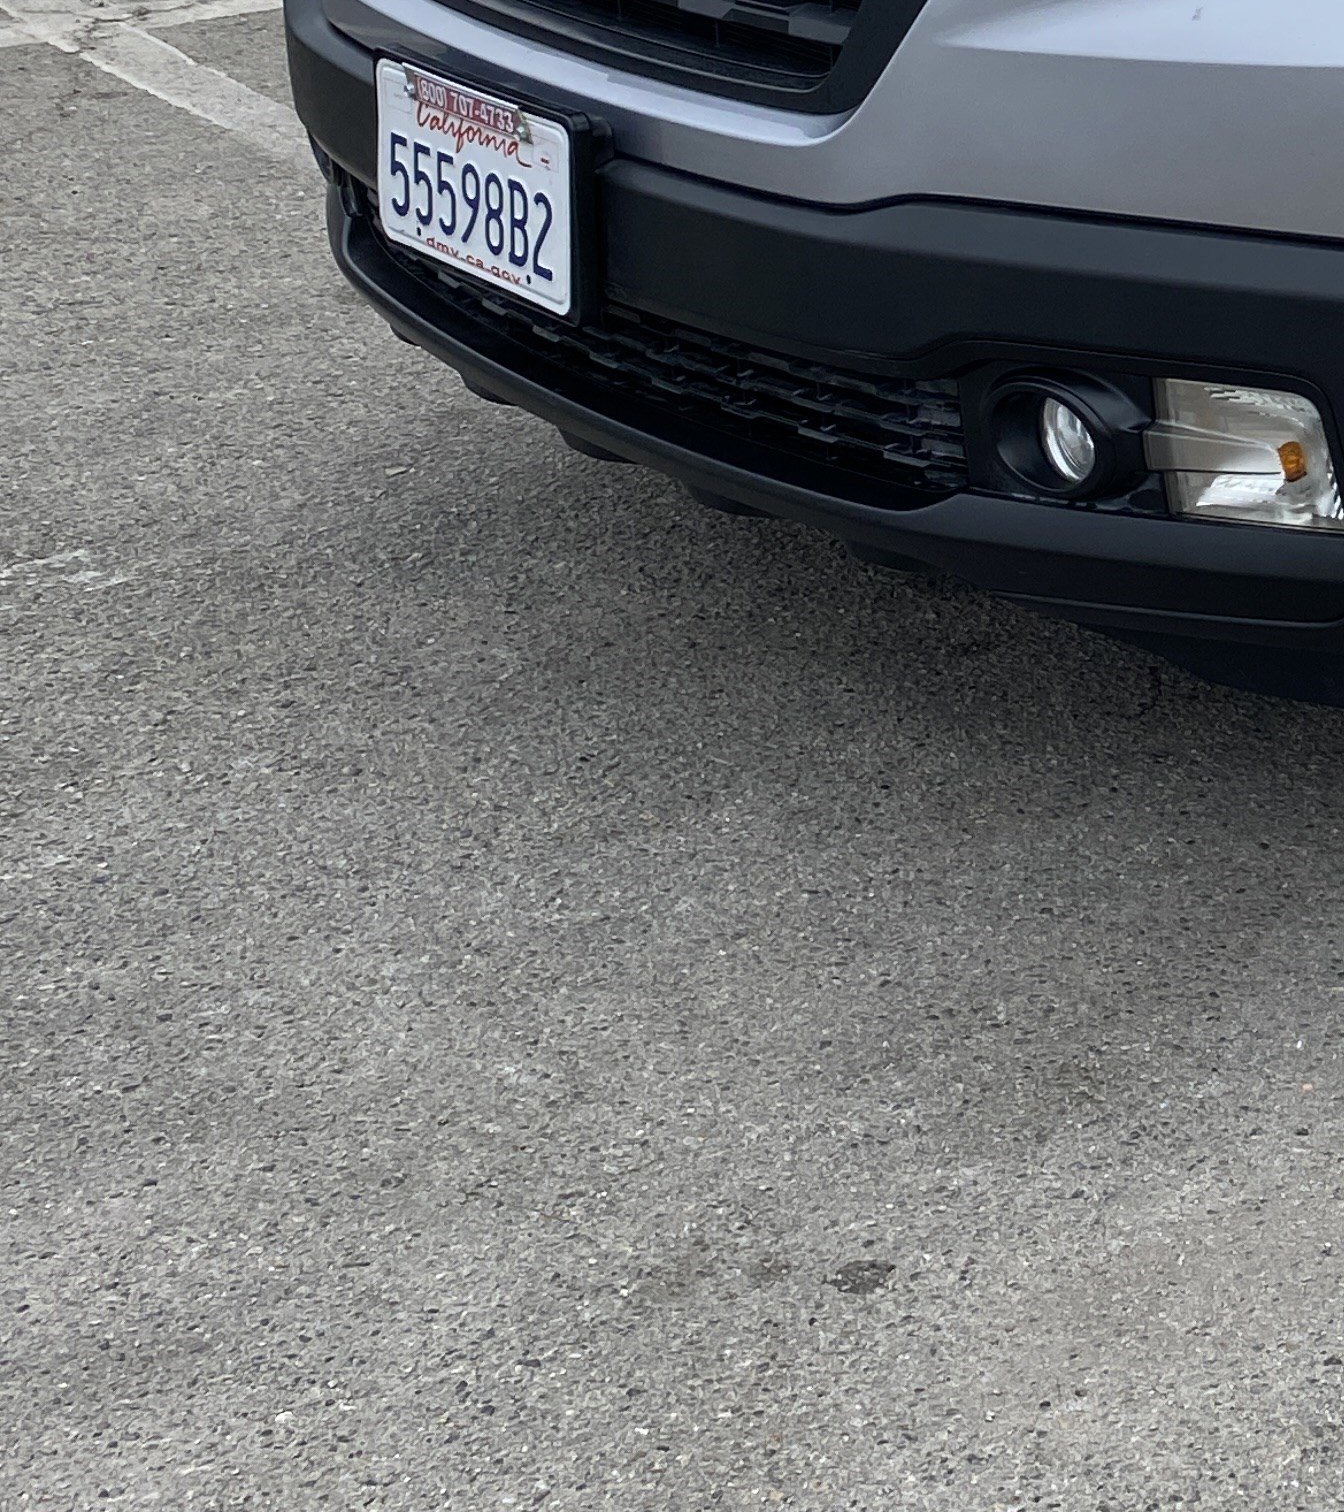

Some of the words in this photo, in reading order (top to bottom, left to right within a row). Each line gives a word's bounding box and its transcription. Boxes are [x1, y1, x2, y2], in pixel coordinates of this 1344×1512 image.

[417, 75, 447, 109] (800)
[450, 91, 514, 133] 707-4733
[390, 131, 553, 282] 55598B2
